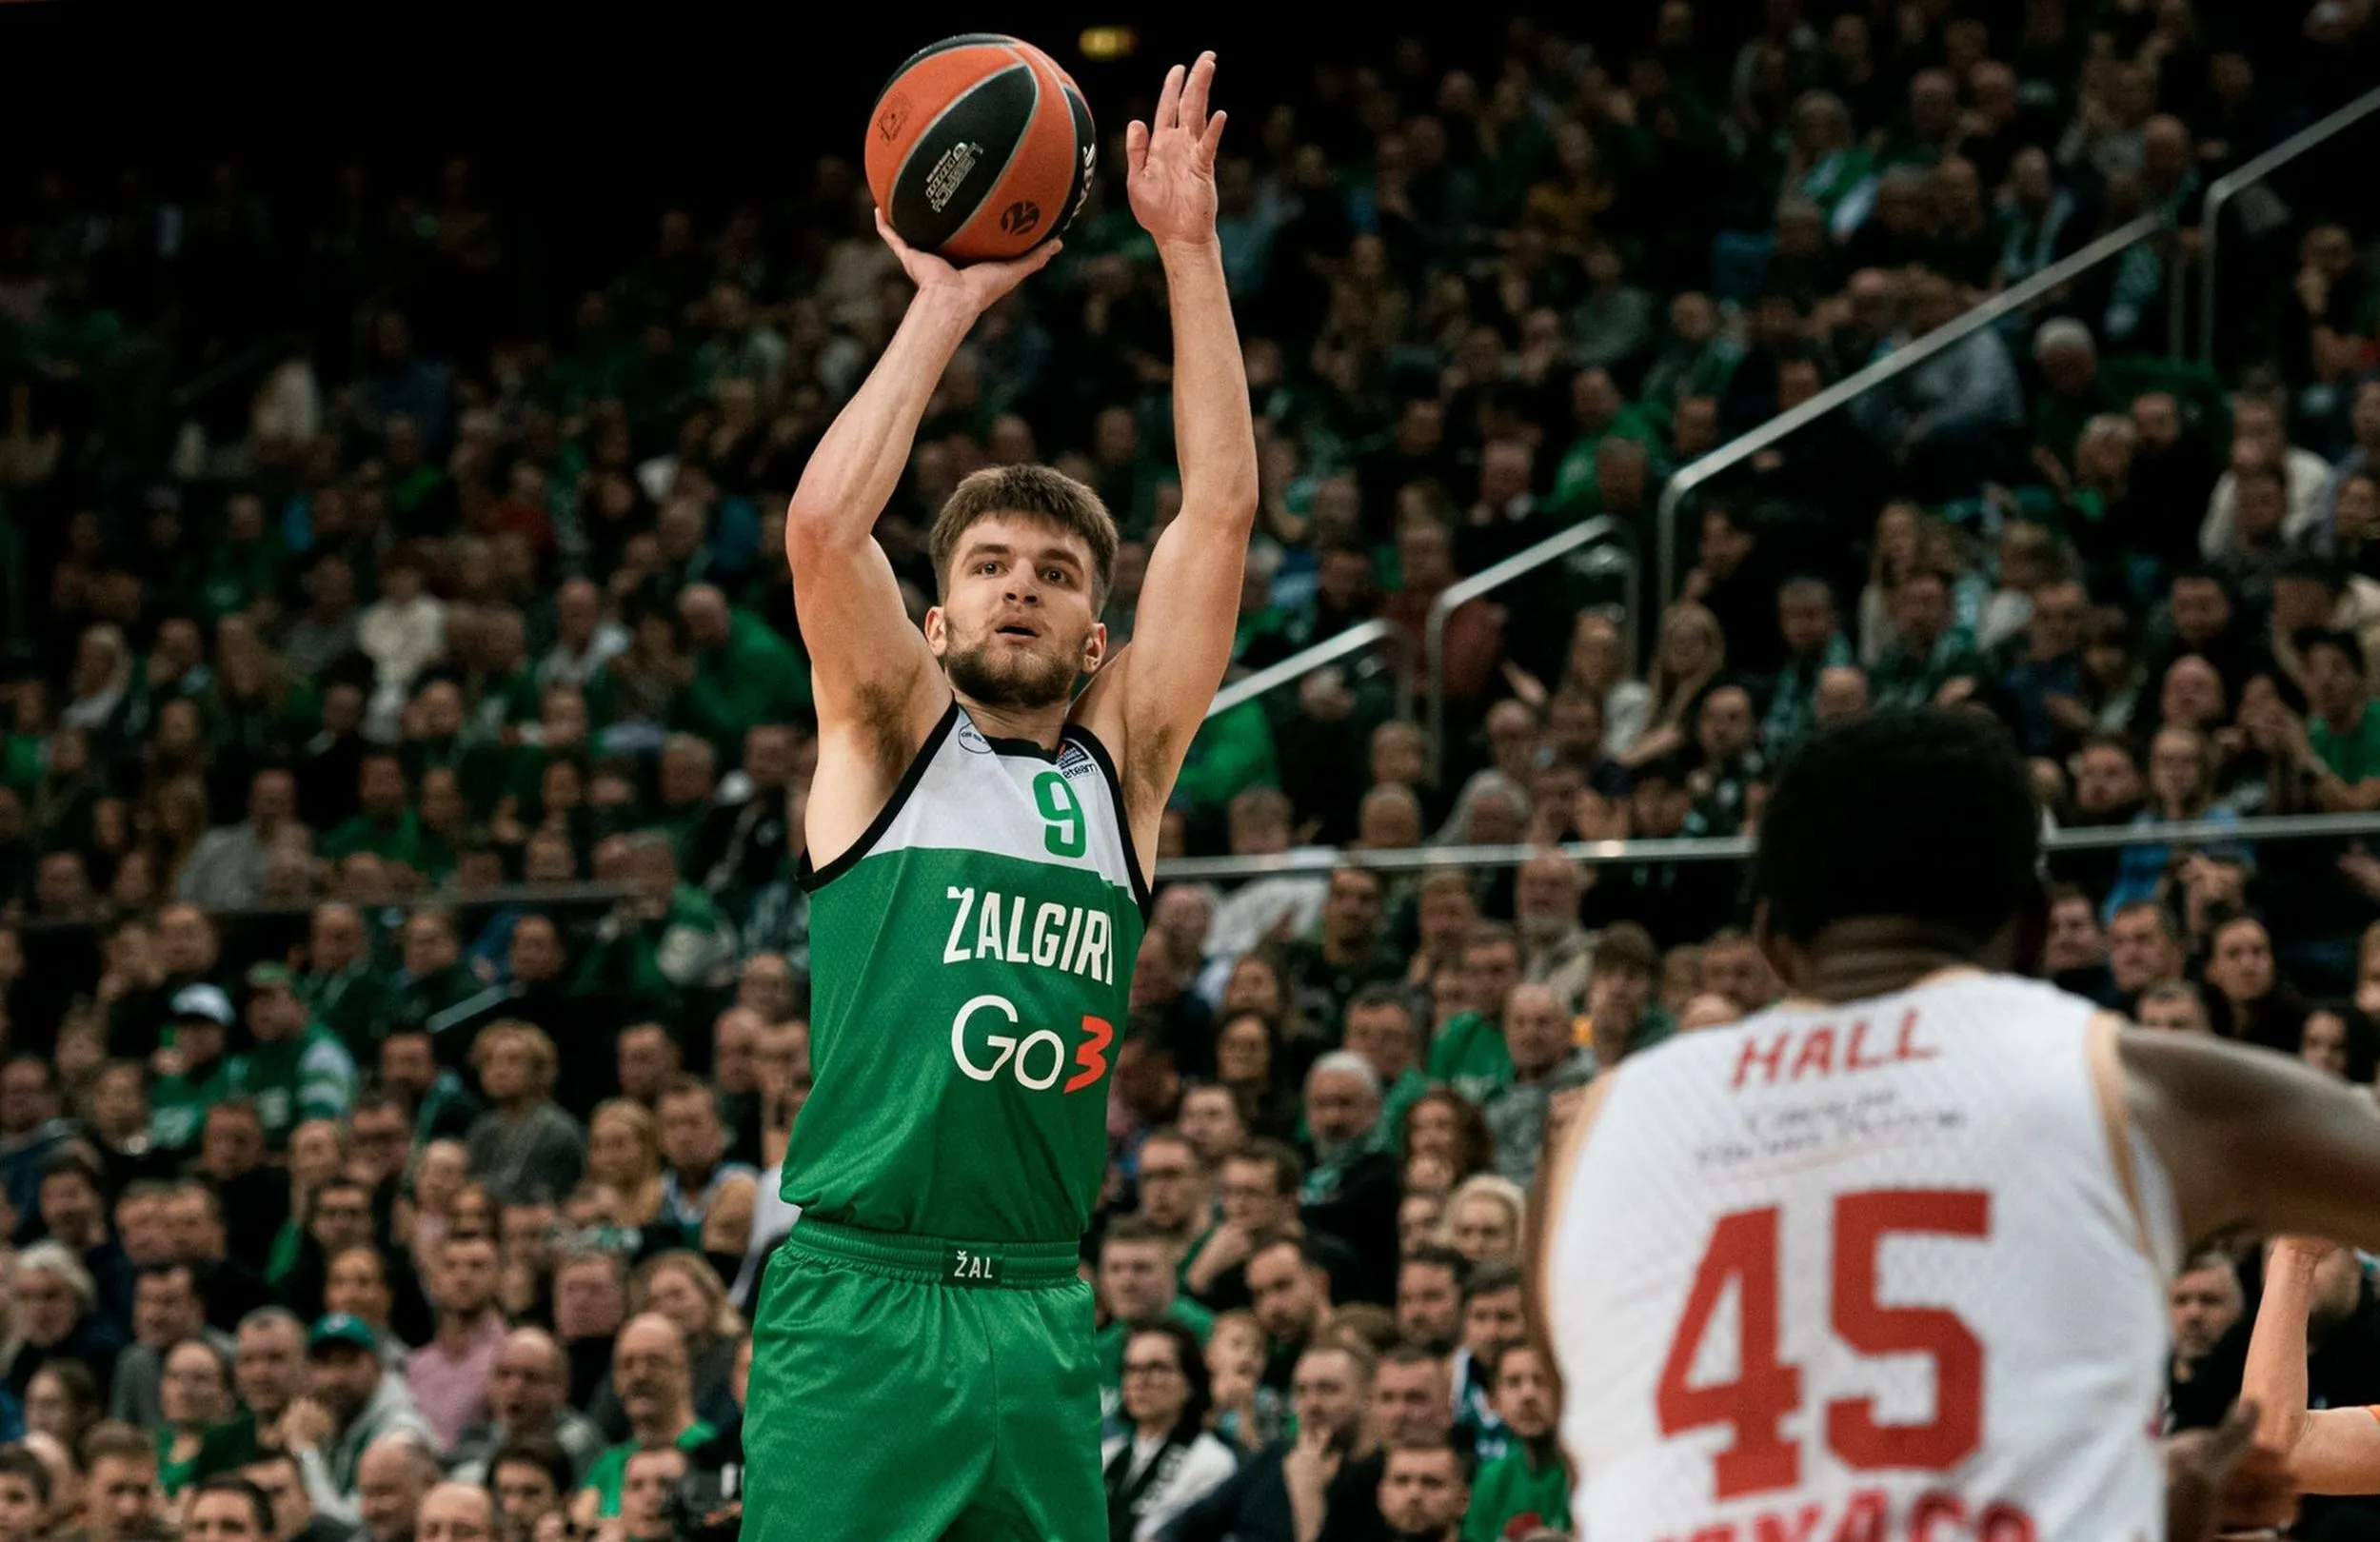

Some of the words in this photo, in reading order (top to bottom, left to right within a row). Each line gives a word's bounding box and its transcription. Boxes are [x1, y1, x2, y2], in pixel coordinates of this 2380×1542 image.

[1032, 770, 1086, 859] 9
[1730, 1007, 1942, 1091] HALL
[954, 1250, 993, 1278] ŽAL
[1654, 1186, 1993, 1501] 45
